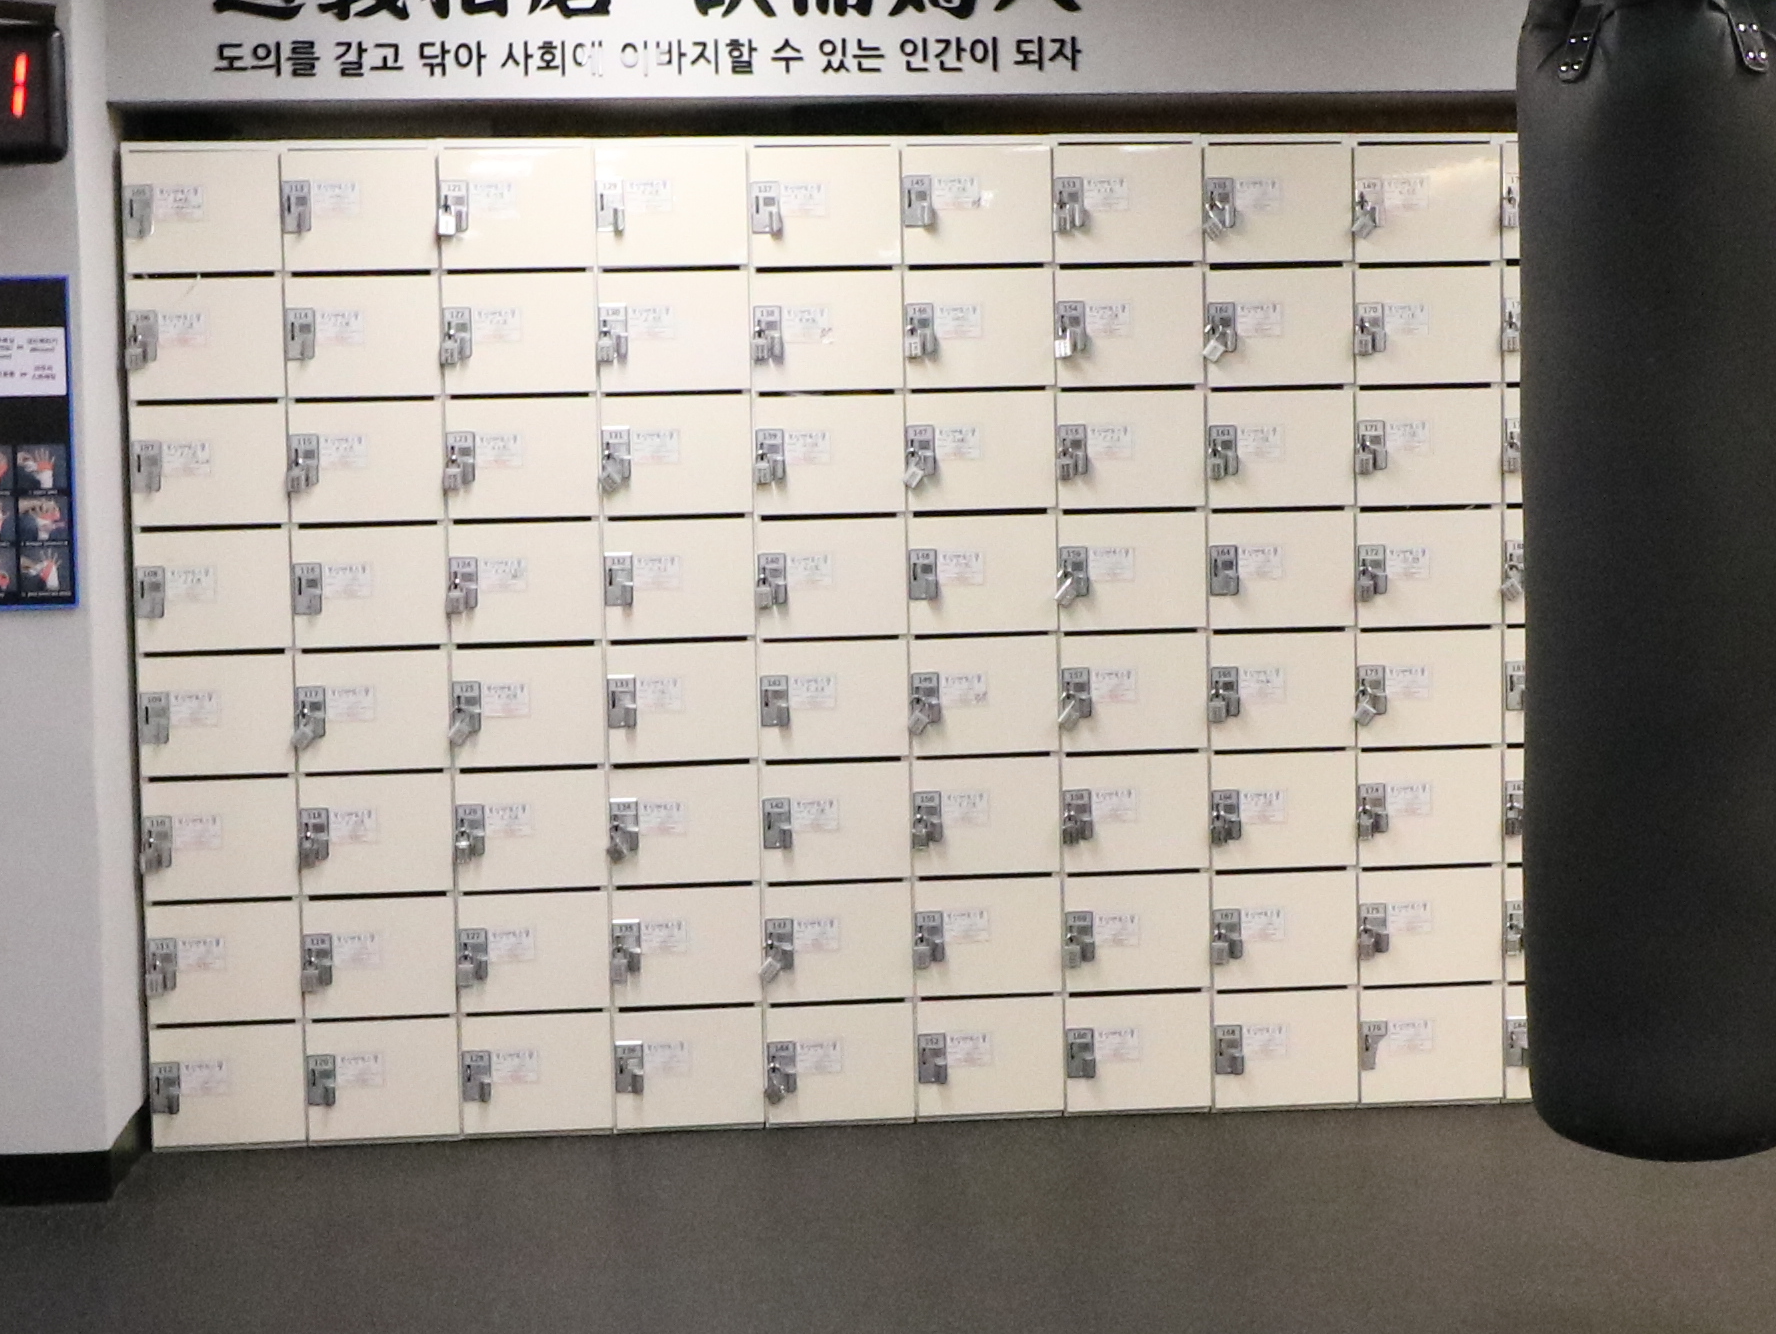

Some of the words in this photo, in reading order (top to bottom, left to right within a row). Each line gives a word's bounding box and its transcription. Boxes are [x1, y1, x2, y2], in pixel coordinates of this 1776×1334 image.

[213, 40, 321, 78] 도의를
[334, 40, 405, 77] 갈고
[418, 40, 488, 77] 닦아
[500, 39, 604, 77] 사회에
[620, 37, 758, 76] 이바지할
[770, 37, 805, 75] 수
[818, 37, 885, 74] 있는
[898, 36, 1000, 74] 인간이
[1012, 35, 1082, 73] 되자
